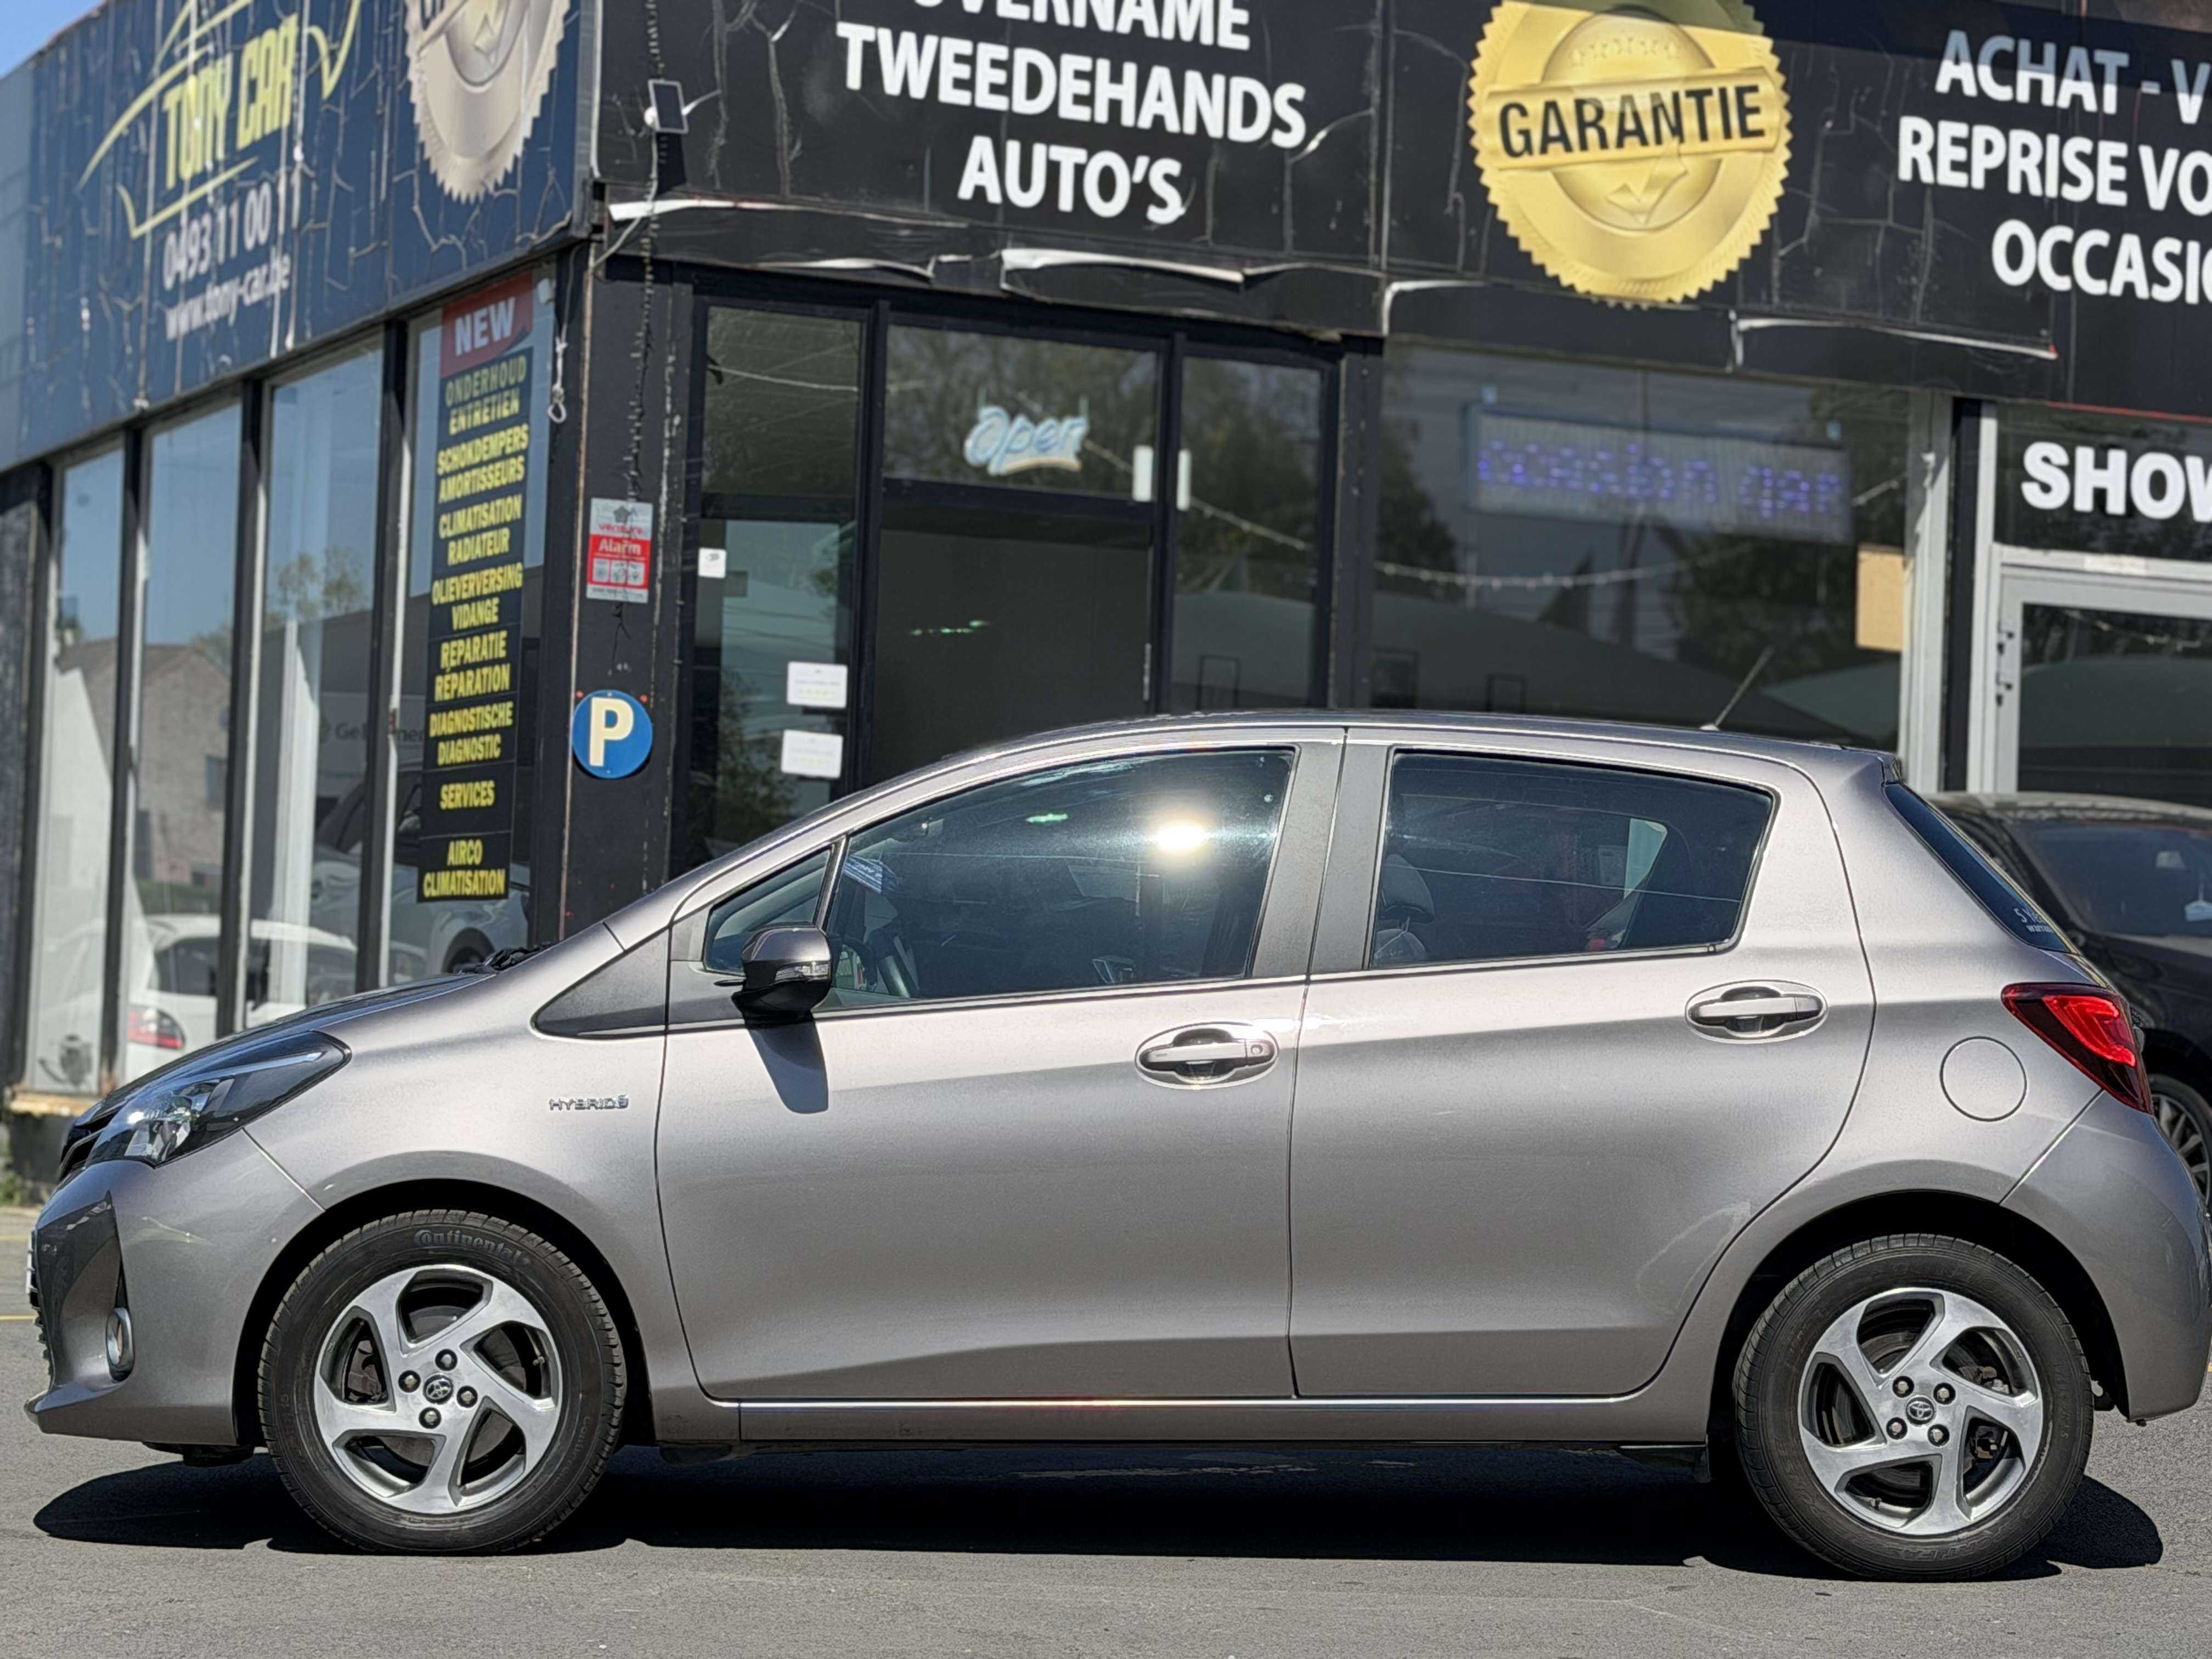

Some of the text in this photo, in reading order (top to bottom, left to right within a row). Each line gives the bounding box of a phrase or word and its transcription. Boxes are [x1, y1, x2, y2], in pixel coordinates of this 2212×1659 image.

[837, 21, 1306, 149] TWEEDEHANDS
[1935, 29, 2129, 114] ACHAT
[162, 13, 298, 190] TONY CAR
[1498, 83, 1766, 159] GARANTIE
[957, 136, 1183, 225] AUTO'S
[1898, 116, 2128, 206] REPRISE
[163, 212, 212, 290] 0493
[217, 198, 239, 264] 11
[244, 181, 272, 252] 00
[1992, 219, 2212, 305] OCCASI
[455, 296, 516, 357] NEW
[445, 355, 527, 408] ONDERHOUD
[449, 386, 520, 435] ENTRETIEN
[437, 422, 529, 476] SCHOKDEMPERS
[963, 405, 1090, 475] Open
[438, 455, 526, 504] AMORTISSEURS
[439, 493, 523, 539] CLIMATISATION
[448, 527, 510, 566] RADIATEUR
[598, 538, 641, 555] Alarm
[432, 562, 523, 606] OLIEVERVERSING
[452, 597, 500, 630] VIDANGE
[441, 630, 507, 670] REPARATIE
[435, 663, 511, 702] RÉPARATION
[429, 701, 514, 737] DIAGNOSTISCHE
[589, 697, 634, 767] P
[437, 733, 501, 765] DIAGNOSTIC
[440, 780, 495, 810] SERVICES
[447, 839, 483, 866] AIRCO
[423, 869, 506, 898] CLIMATISATION
[549, 1098, 616, 1110] HYBRID
[413, 1229, 521, 1263] Continental
